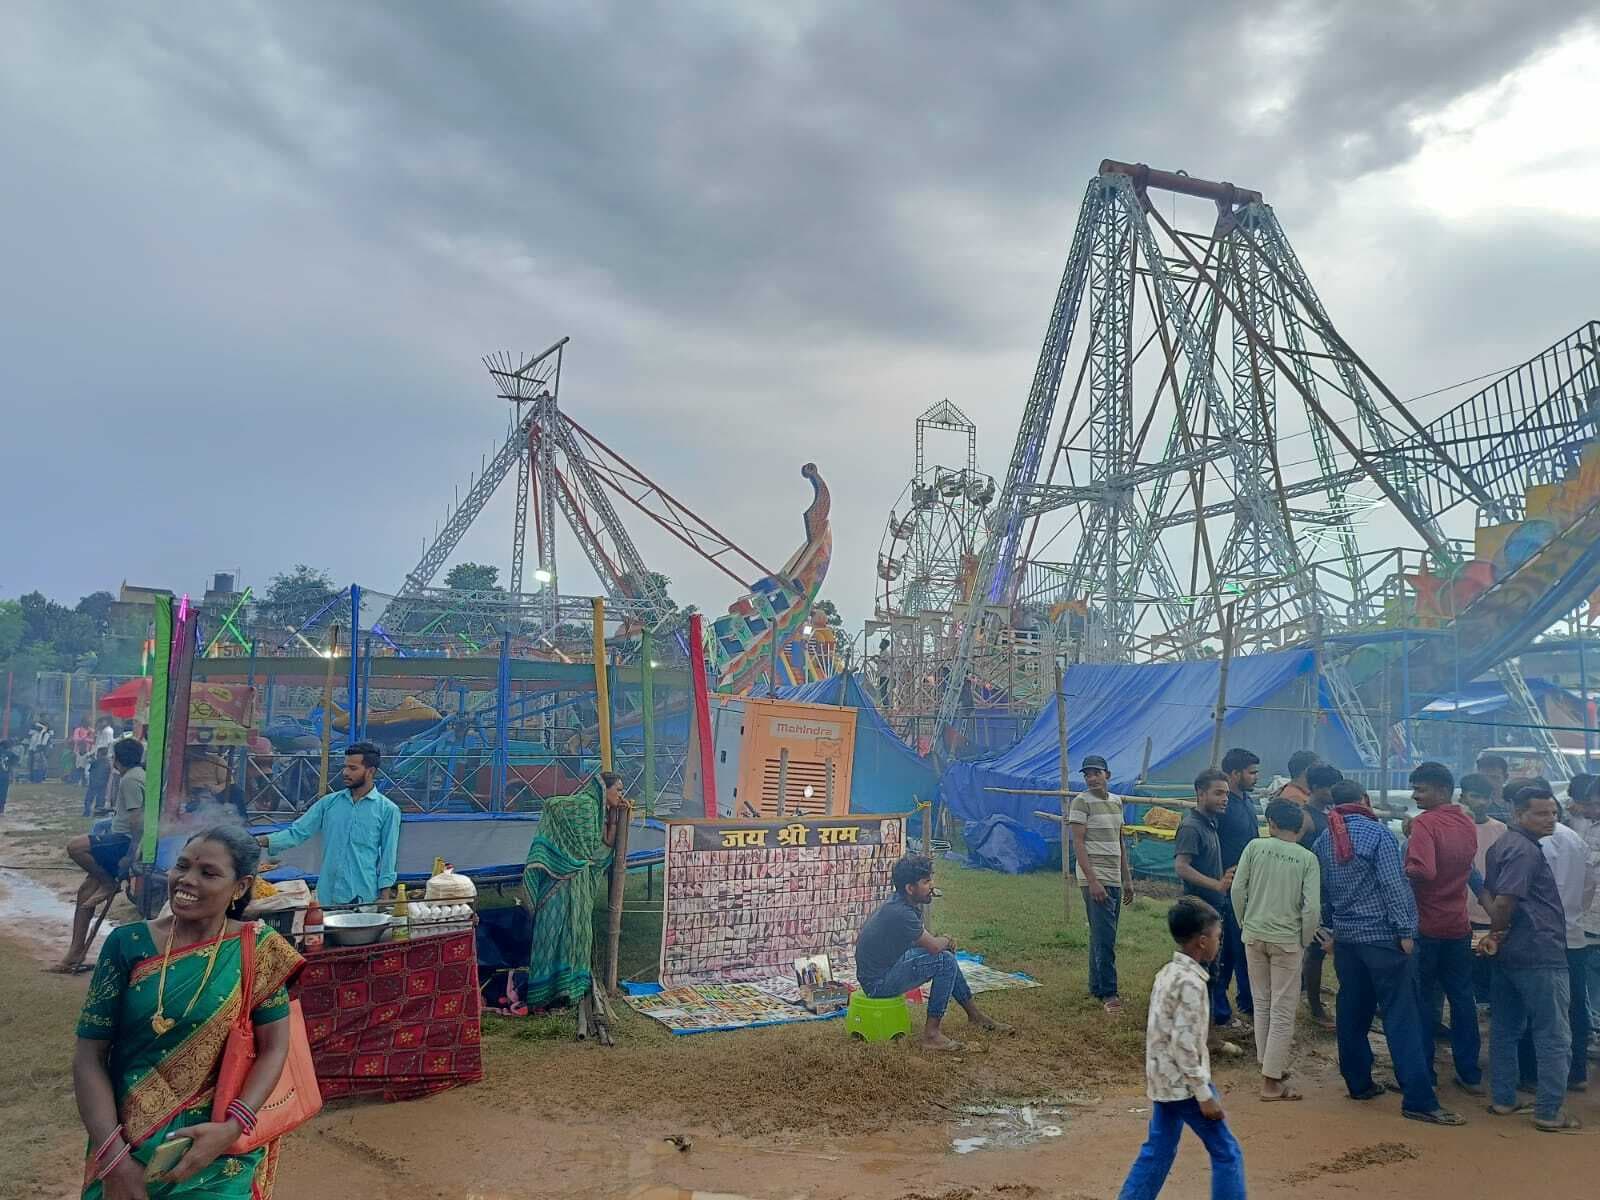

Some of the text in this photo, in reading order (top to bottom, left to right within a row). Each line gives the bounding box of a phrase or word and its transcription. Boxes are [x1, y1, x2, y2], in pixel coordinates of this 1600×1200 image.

[718, 823, 859, 847] जय श्री राम
